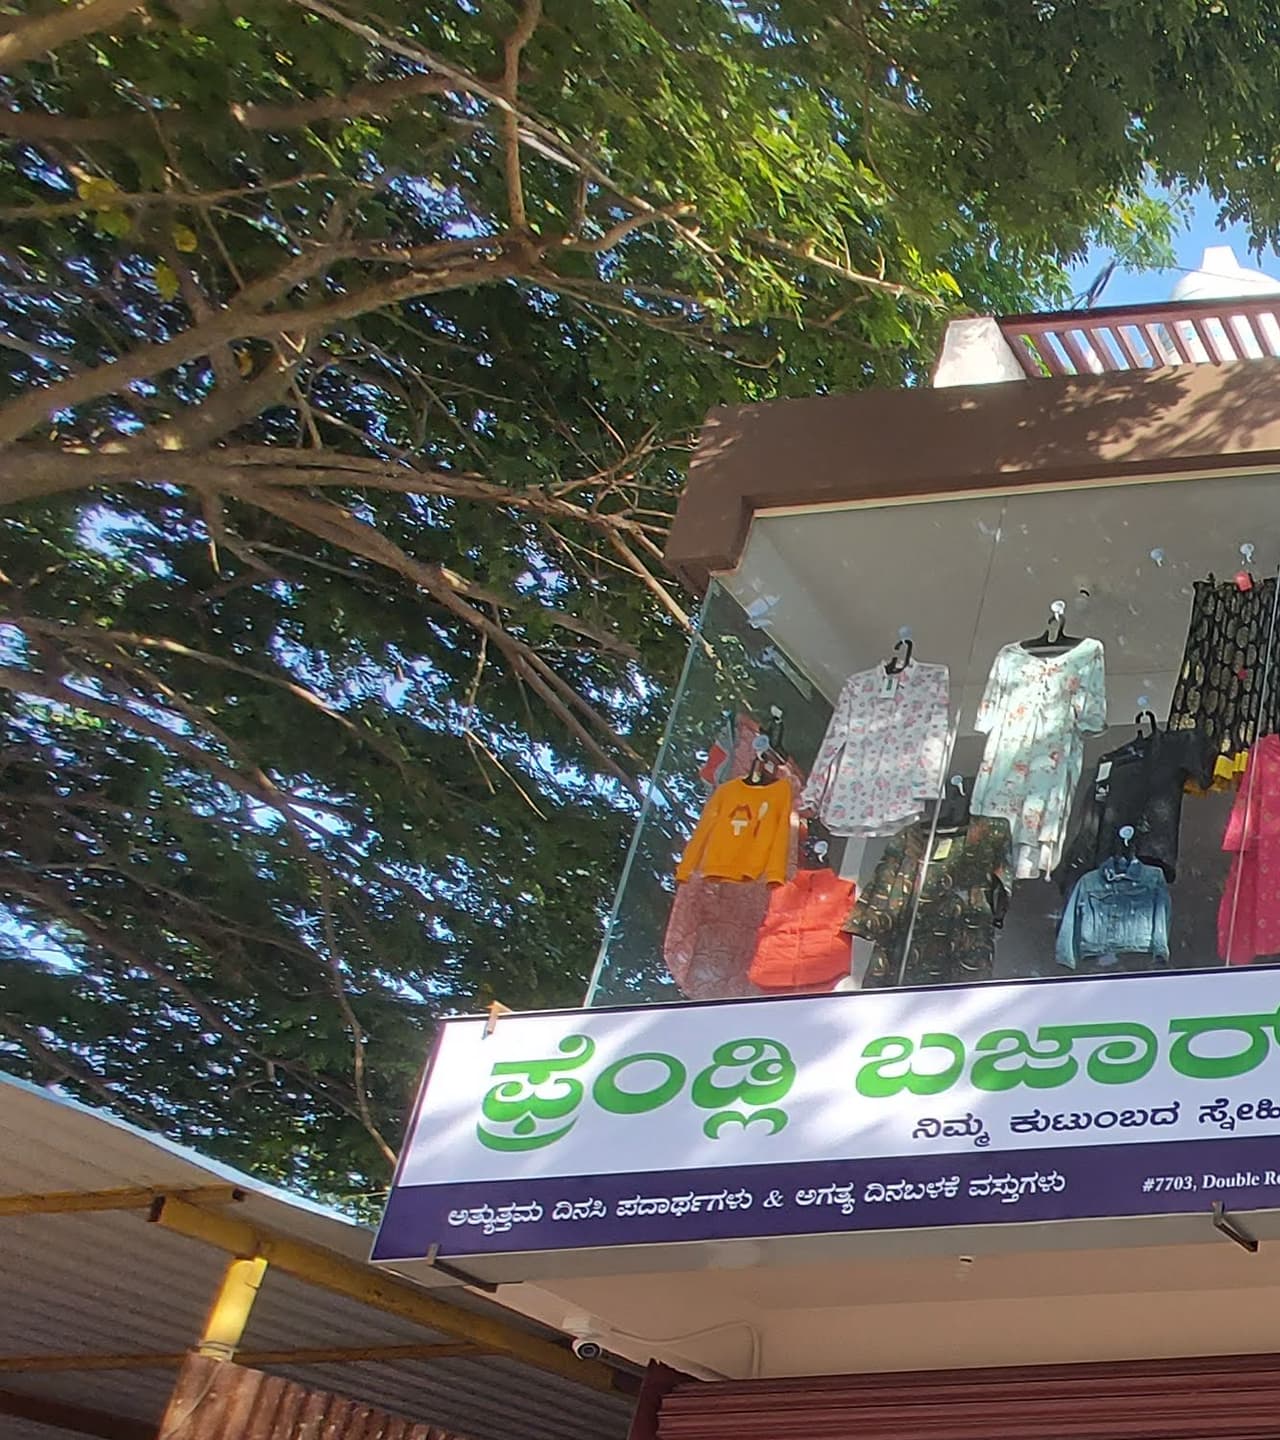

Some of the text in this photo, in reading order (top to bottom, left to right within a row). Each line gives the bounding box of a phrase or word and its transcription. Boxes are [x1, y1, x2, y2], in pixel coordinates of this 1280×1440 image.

[911, 1111, 991, 1147] ನಿಮ್ಮ
[1009, 1099, 1181, 1135] ಕುಟುಂಬದ
[447, 1200, 544, 1235] ಅತ್ಯುತ್ತಮ
[552, 1197, 607, 1221] ದಿನಸಿ
[763, 1189, 785, 1209] &
[795, 1181, 855, 1215] ಅಗತ್ಯ
[863, 1175, 961, 1203] ದಿನಬಳಕೆ
[968, 1169, 1067, 1204] ವಸ್ತುಗಳು
[1142, 1175, 1200, 1196] #7703,
[1202, 1170, 1261, 1191] Double
